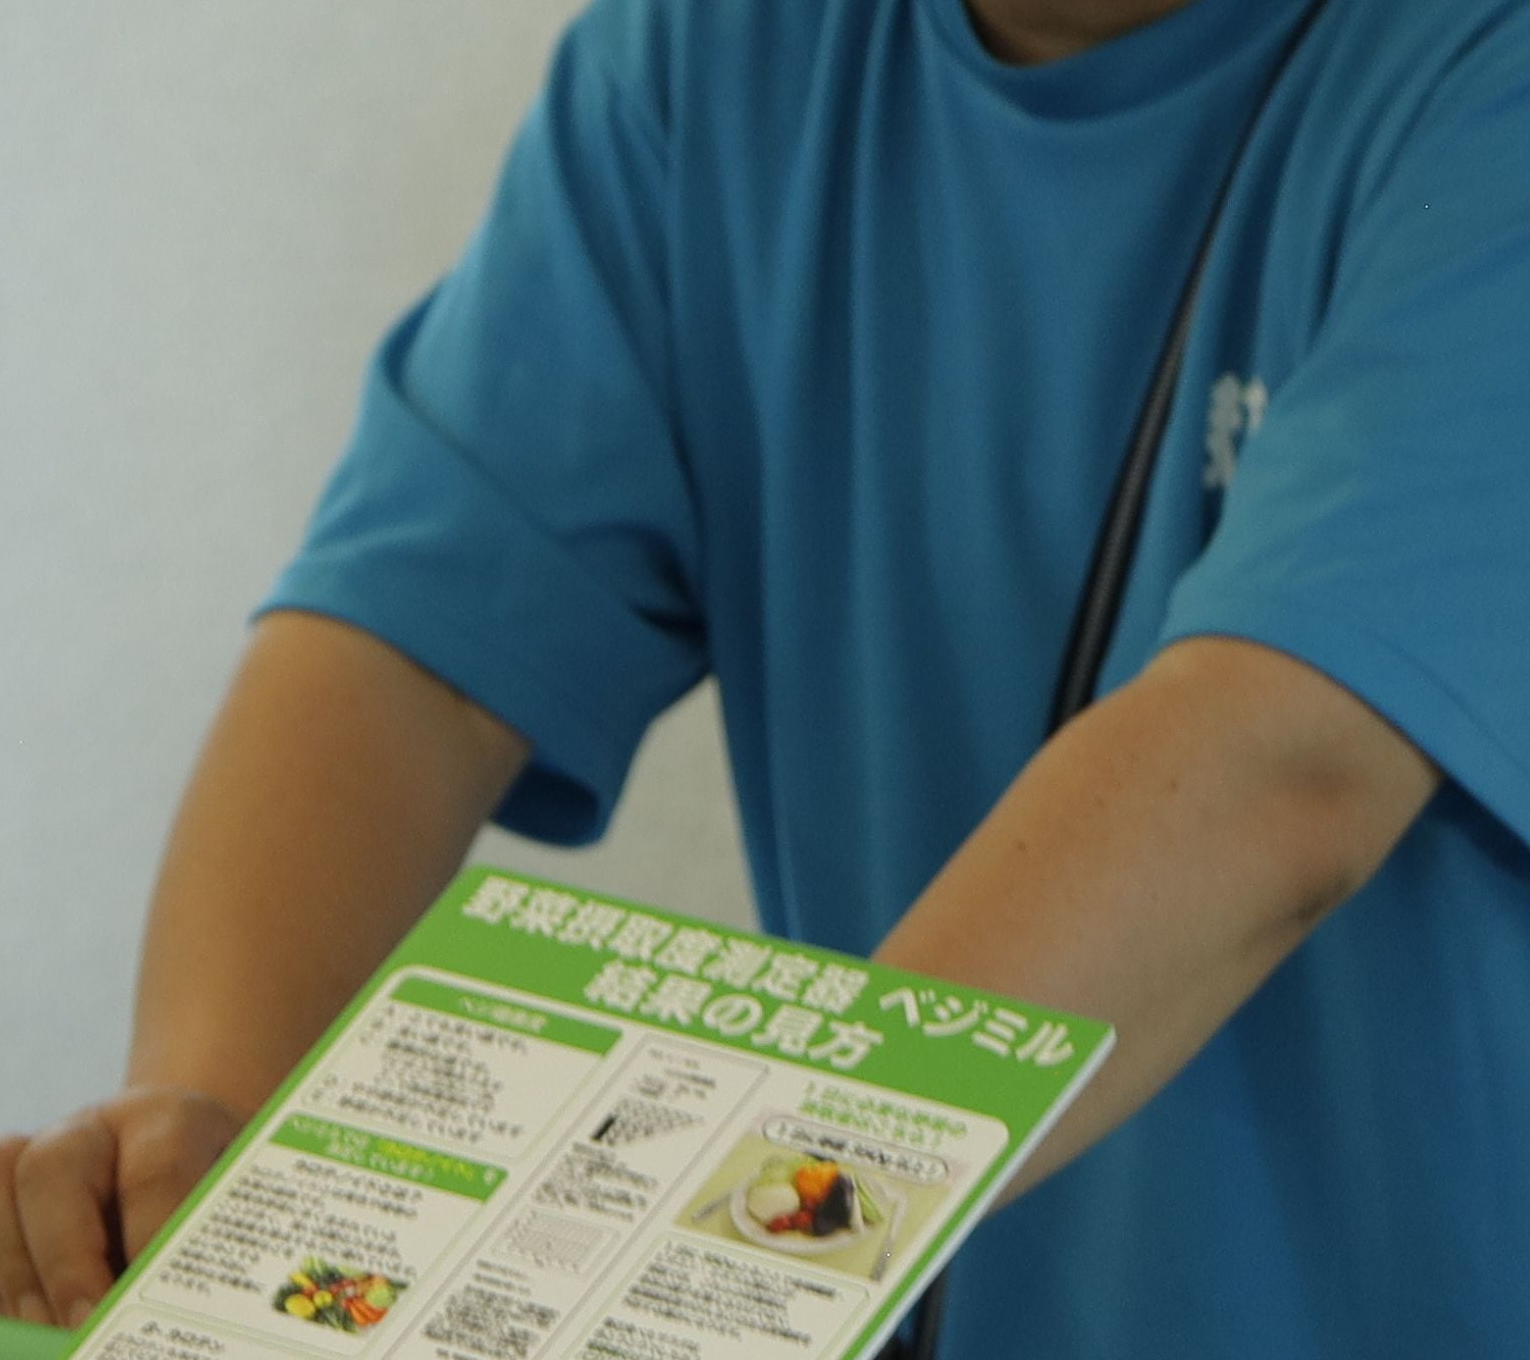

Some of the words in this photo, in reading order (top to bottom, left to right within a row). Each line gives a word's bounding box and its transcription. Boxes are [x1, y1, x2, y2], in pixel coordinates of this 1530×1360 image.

[462, 874, 870, 1015] 野菜摂取度測定器
[878, 984, 1076, 1068] ベジミル
[583, 957, 884, 1070] 結果の見方
